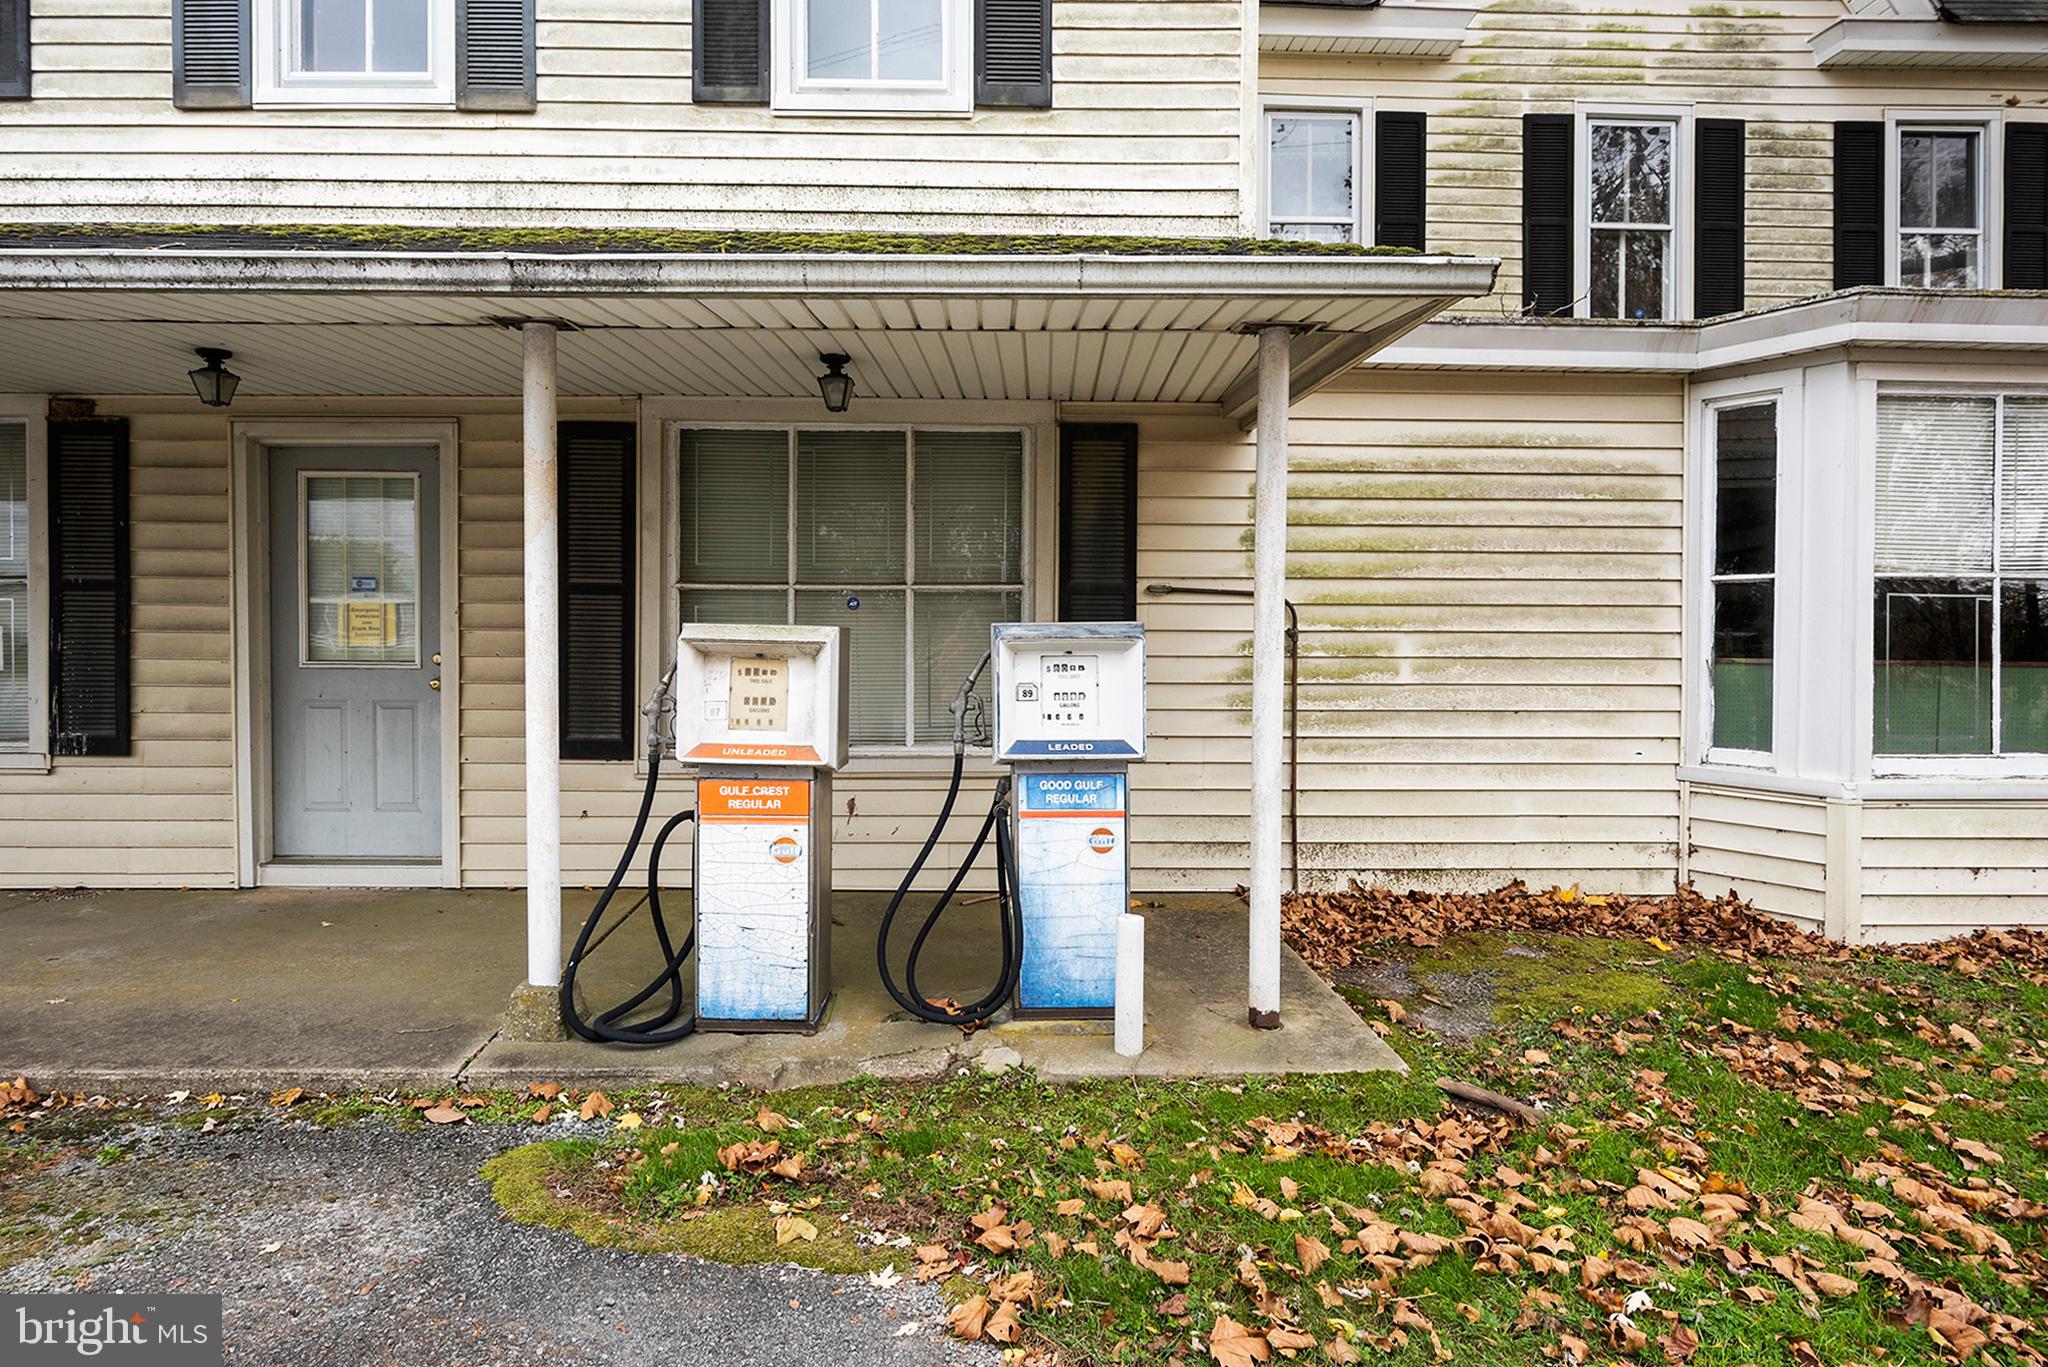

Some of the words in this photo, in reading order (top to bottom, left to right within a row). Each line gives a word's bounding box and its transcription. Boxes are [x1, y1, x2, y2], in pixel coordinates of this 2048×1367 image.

[1022, 689, 1034, 698] 89
[710, 708, 721, 717] 87
[722, 747, 787, 757] UNLEADED
[1047, 743, 1094, 751] LEADED
[1039, 780, 1072, 790] GOOD
[1074, 780, 1103, 790] GULF
[719, 785, 749, 795] GULF
[752, 786, 790, 796] CREST
[1045, 793, 1098, 804] REGULAR
[727, 799, 782, 809] REGULAR
